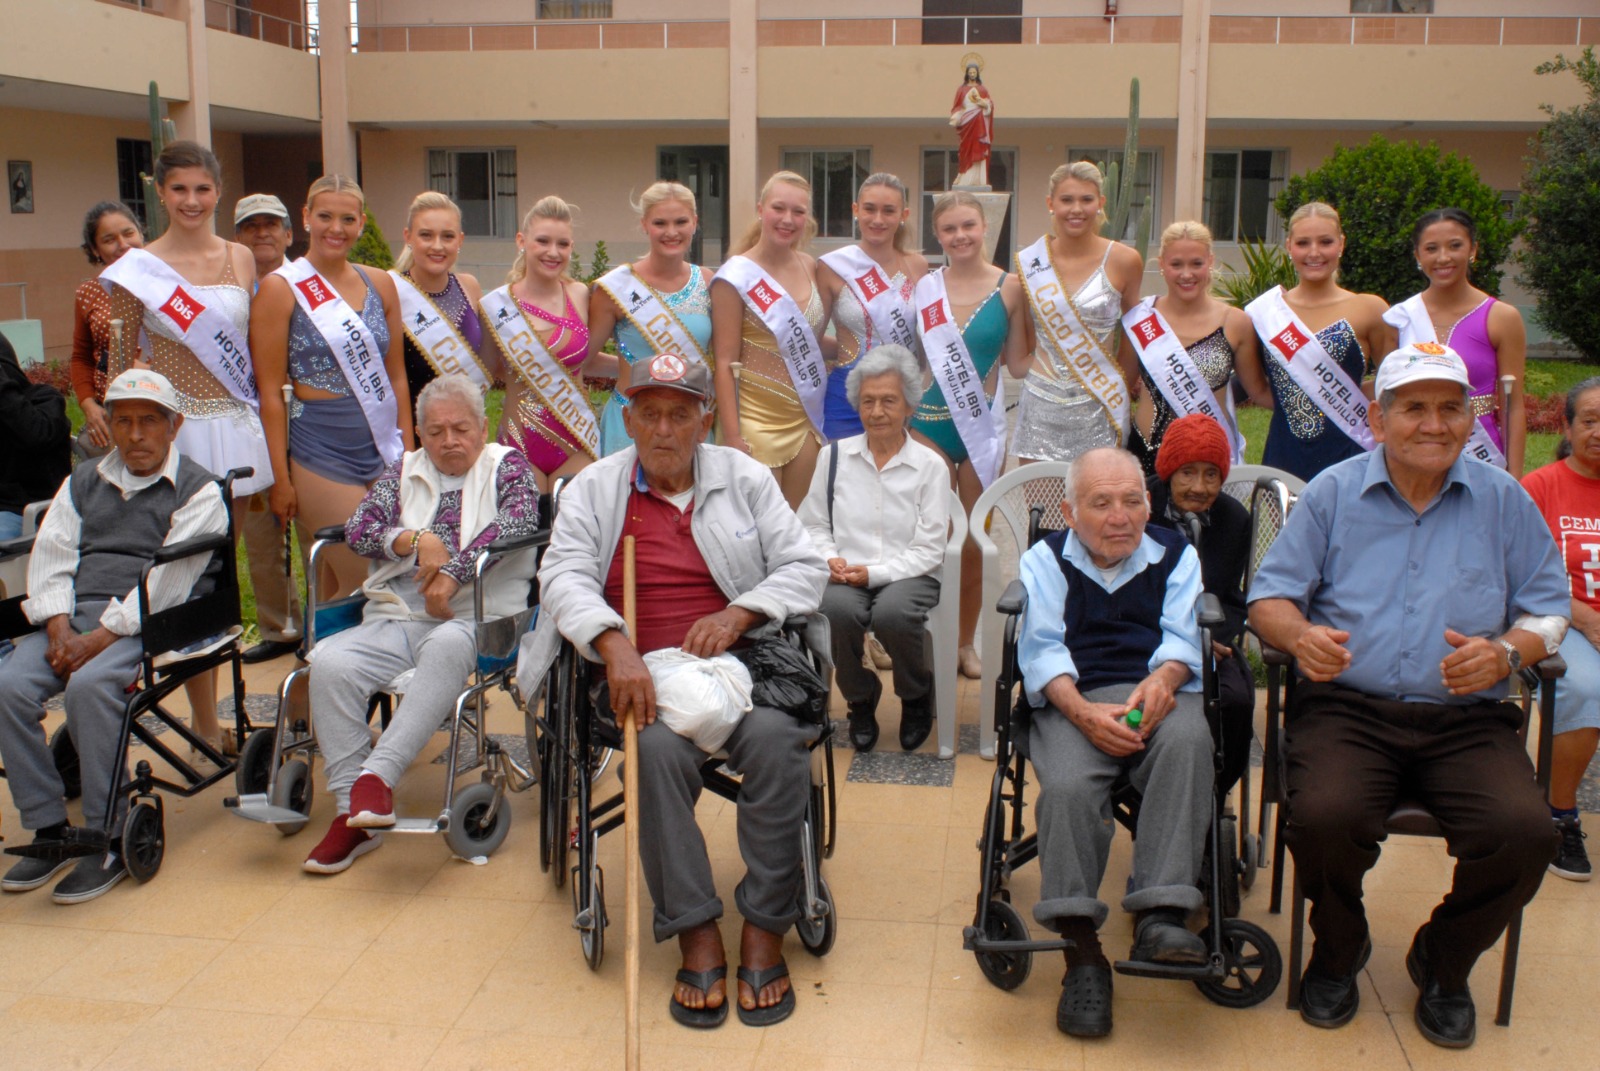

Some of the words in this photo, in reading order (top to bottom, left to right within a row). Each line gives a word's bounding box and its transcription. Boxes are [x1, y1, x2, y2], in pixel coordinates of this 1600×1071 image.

[305, 279, 325, 302] ibis
[754, 285, 773, 305] ibis
[863, 275, 879, 295] ibis
[169, 296, 194, 320] ibis
[890, 308, 914, 349] HOTEL
[927, 305, 938, 326] ibis
[646, 312, 688, 359] Coc
[787, 316, 811, 361] HOTEL
[807, 361, 822, 388] IBIS
[1035, 282, 1073, 341] Coco
[1067, 332, 1124, 410] Torete
[1140, 321, 1156, 341] ibis
[1280, 330, 1299, 351] ibis
[214, 330, 248, 375] HOTEL
[342, 319, 371, 370] HOTEL
[369, 371, 386, 402] IBIS
[342, 341, 371, 394] TRUJILLO
[787, 336, 808, 381] TRUJILLO
[219, 355, 250, 397] TRUJILLO
[508, 330, 553, 389] Coco
[551, 378, 599, 447] Torete
[942, 361, 966, 410] TRUJILLO
[946, 342, 971, 389] HOTEL
[966, 390, 982, 418] IBIS
[1166, 353, 1199, 399] HOTEL
[1166, 375, 1195, 415] TRUJILL
[1313, 362, 1353, 404] HOTEL
[1317, 386, 1358, 427] TRUJILLO
